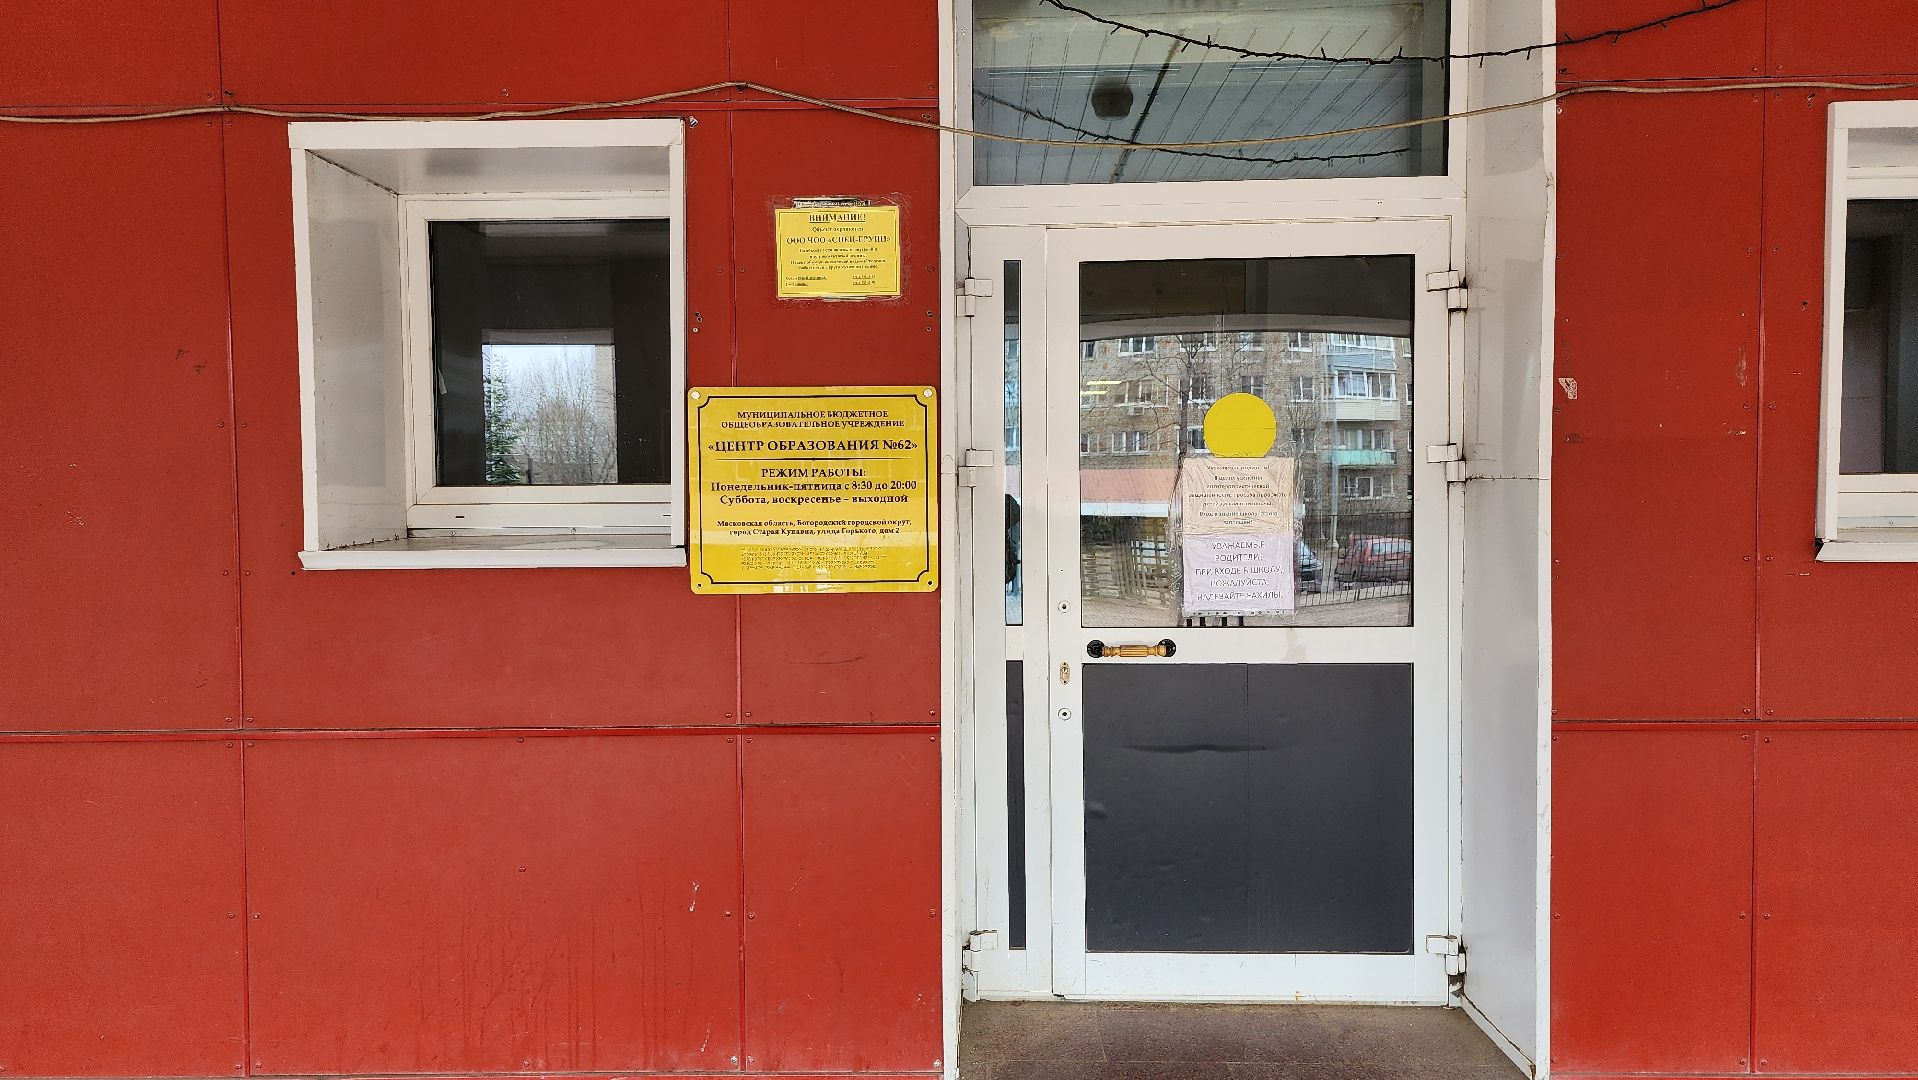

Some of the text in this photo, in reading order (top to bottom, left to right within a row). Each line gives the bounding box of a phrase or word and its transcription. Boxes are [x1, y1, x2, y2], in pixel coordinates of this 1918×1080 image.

[809, 214, 866, 222] ВНИМАНИЕ!
[737, 410, 888, 419] МУНИЦИПАЛЬНОЕ БЮДЖЕТНОЕ
[721, 420, 904, 429] ОБЩЕОБРАЗОВАТЕЛЬНОЕ УЧРЕЖДЕНИЕ
[708, 439, 918, 453] «ЦЕНТР ОБРАЗОВАНИЯ №62»
[761, 468, 866, 477] РЕЖИМ РАБОТЫ:
[711, 482, 842, 492] Понедельник-пятница
[851, 481, 872, 490] 8:30
[874, 482, 888, 492] до
[891, 481, 916, 489] 20:00
[720, 495, 769, 506] Суббота,
[773, 496, 841, 505] воскресенье
[852, 494, 908, 503] выходной
[764, 519, 795, 527] область,
[797, 518, 846, 527] Богородский
[848, 518, 885, 527] городской
[887, 519, 912, 527] округ,
[729, 528, 750, 536] город
[817, 528, 840, 536] улица
[842, 527, 877, 535] Горького,
[1212, 541, 1264, 549] УВАЖАЕМЫЕ
